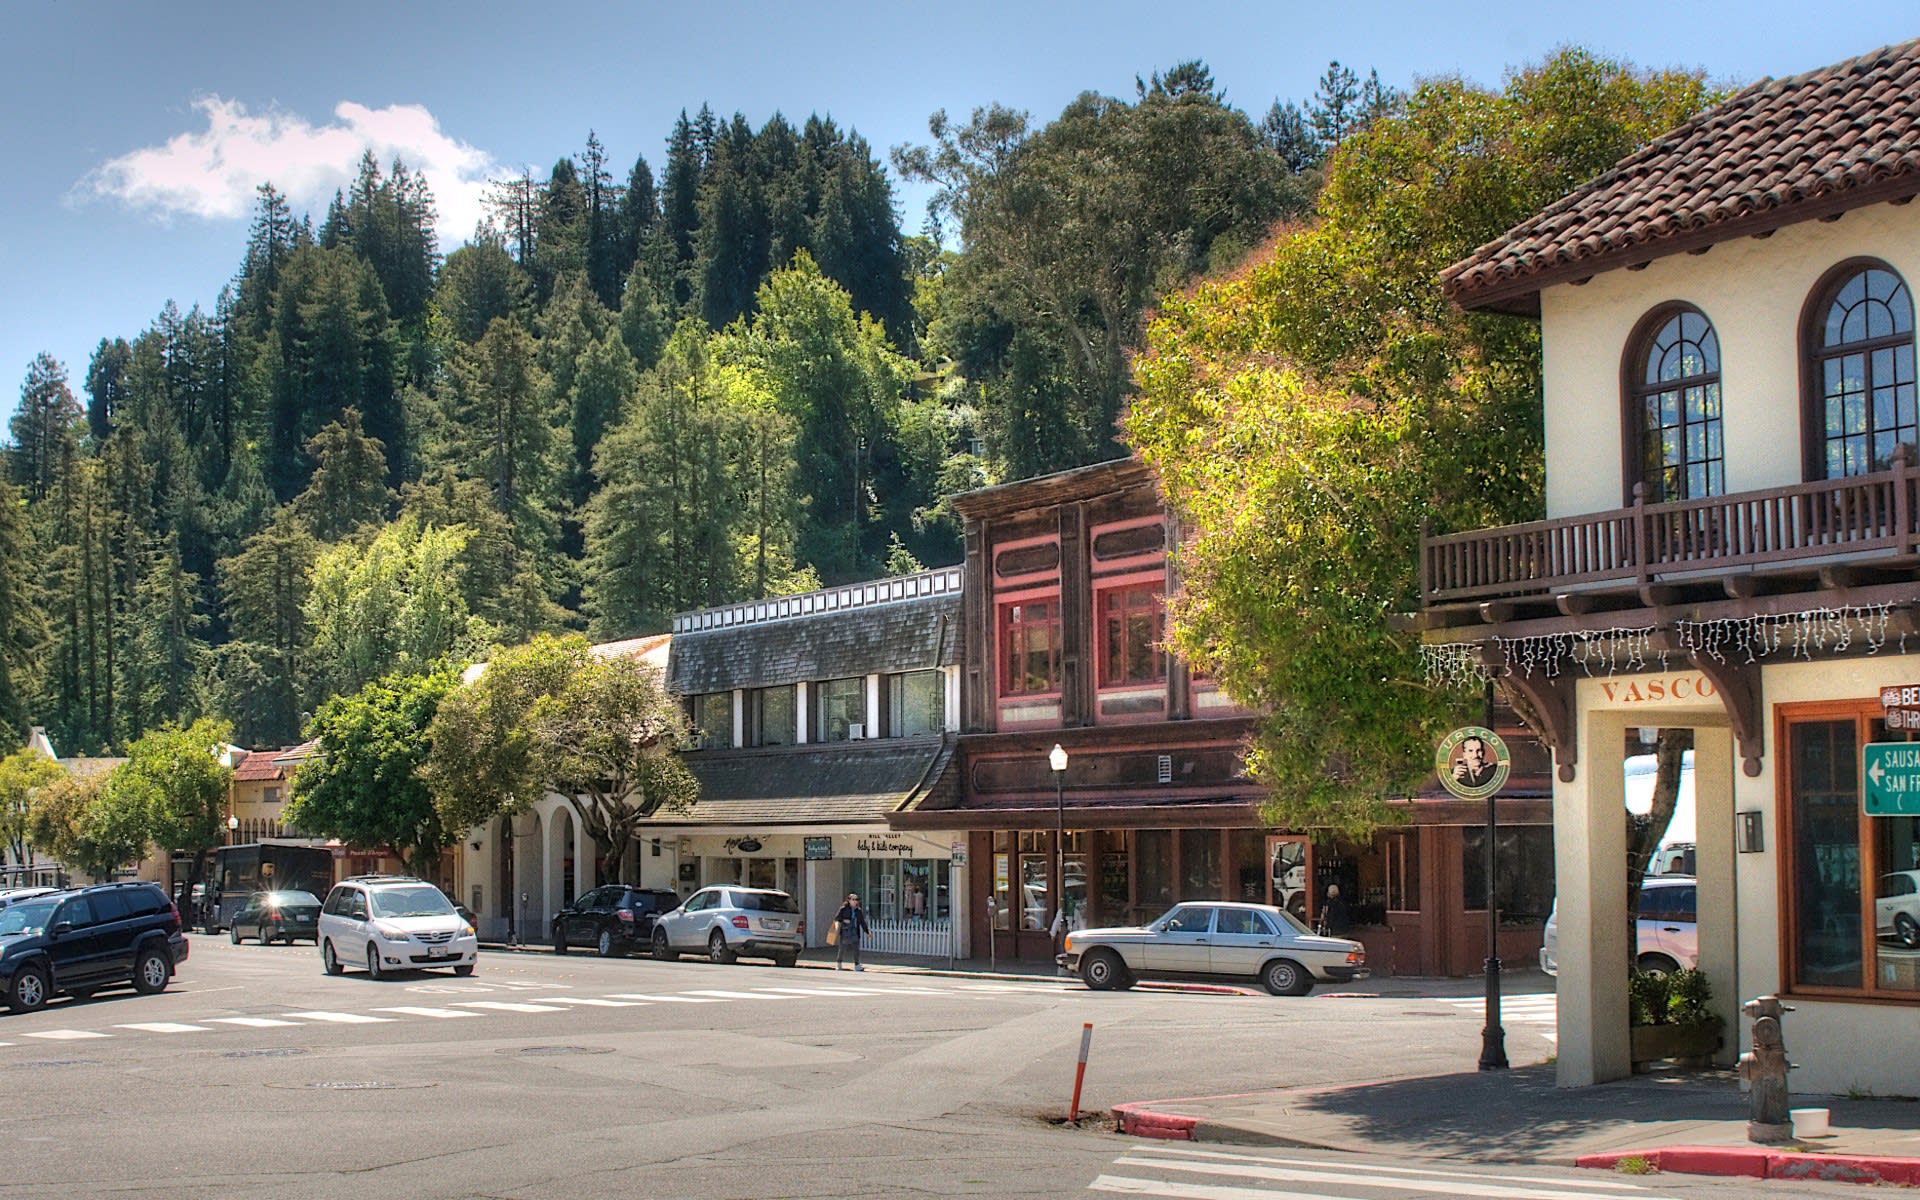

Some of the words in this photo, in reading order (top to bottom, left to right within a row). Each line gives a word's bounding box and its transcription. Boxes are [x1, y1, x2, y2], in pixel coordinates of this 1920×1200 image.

[1600, 676, 1716, 702] VASCO
[1885, 774, 1907, 793] SAN
[888, 843, 913, 858] company
